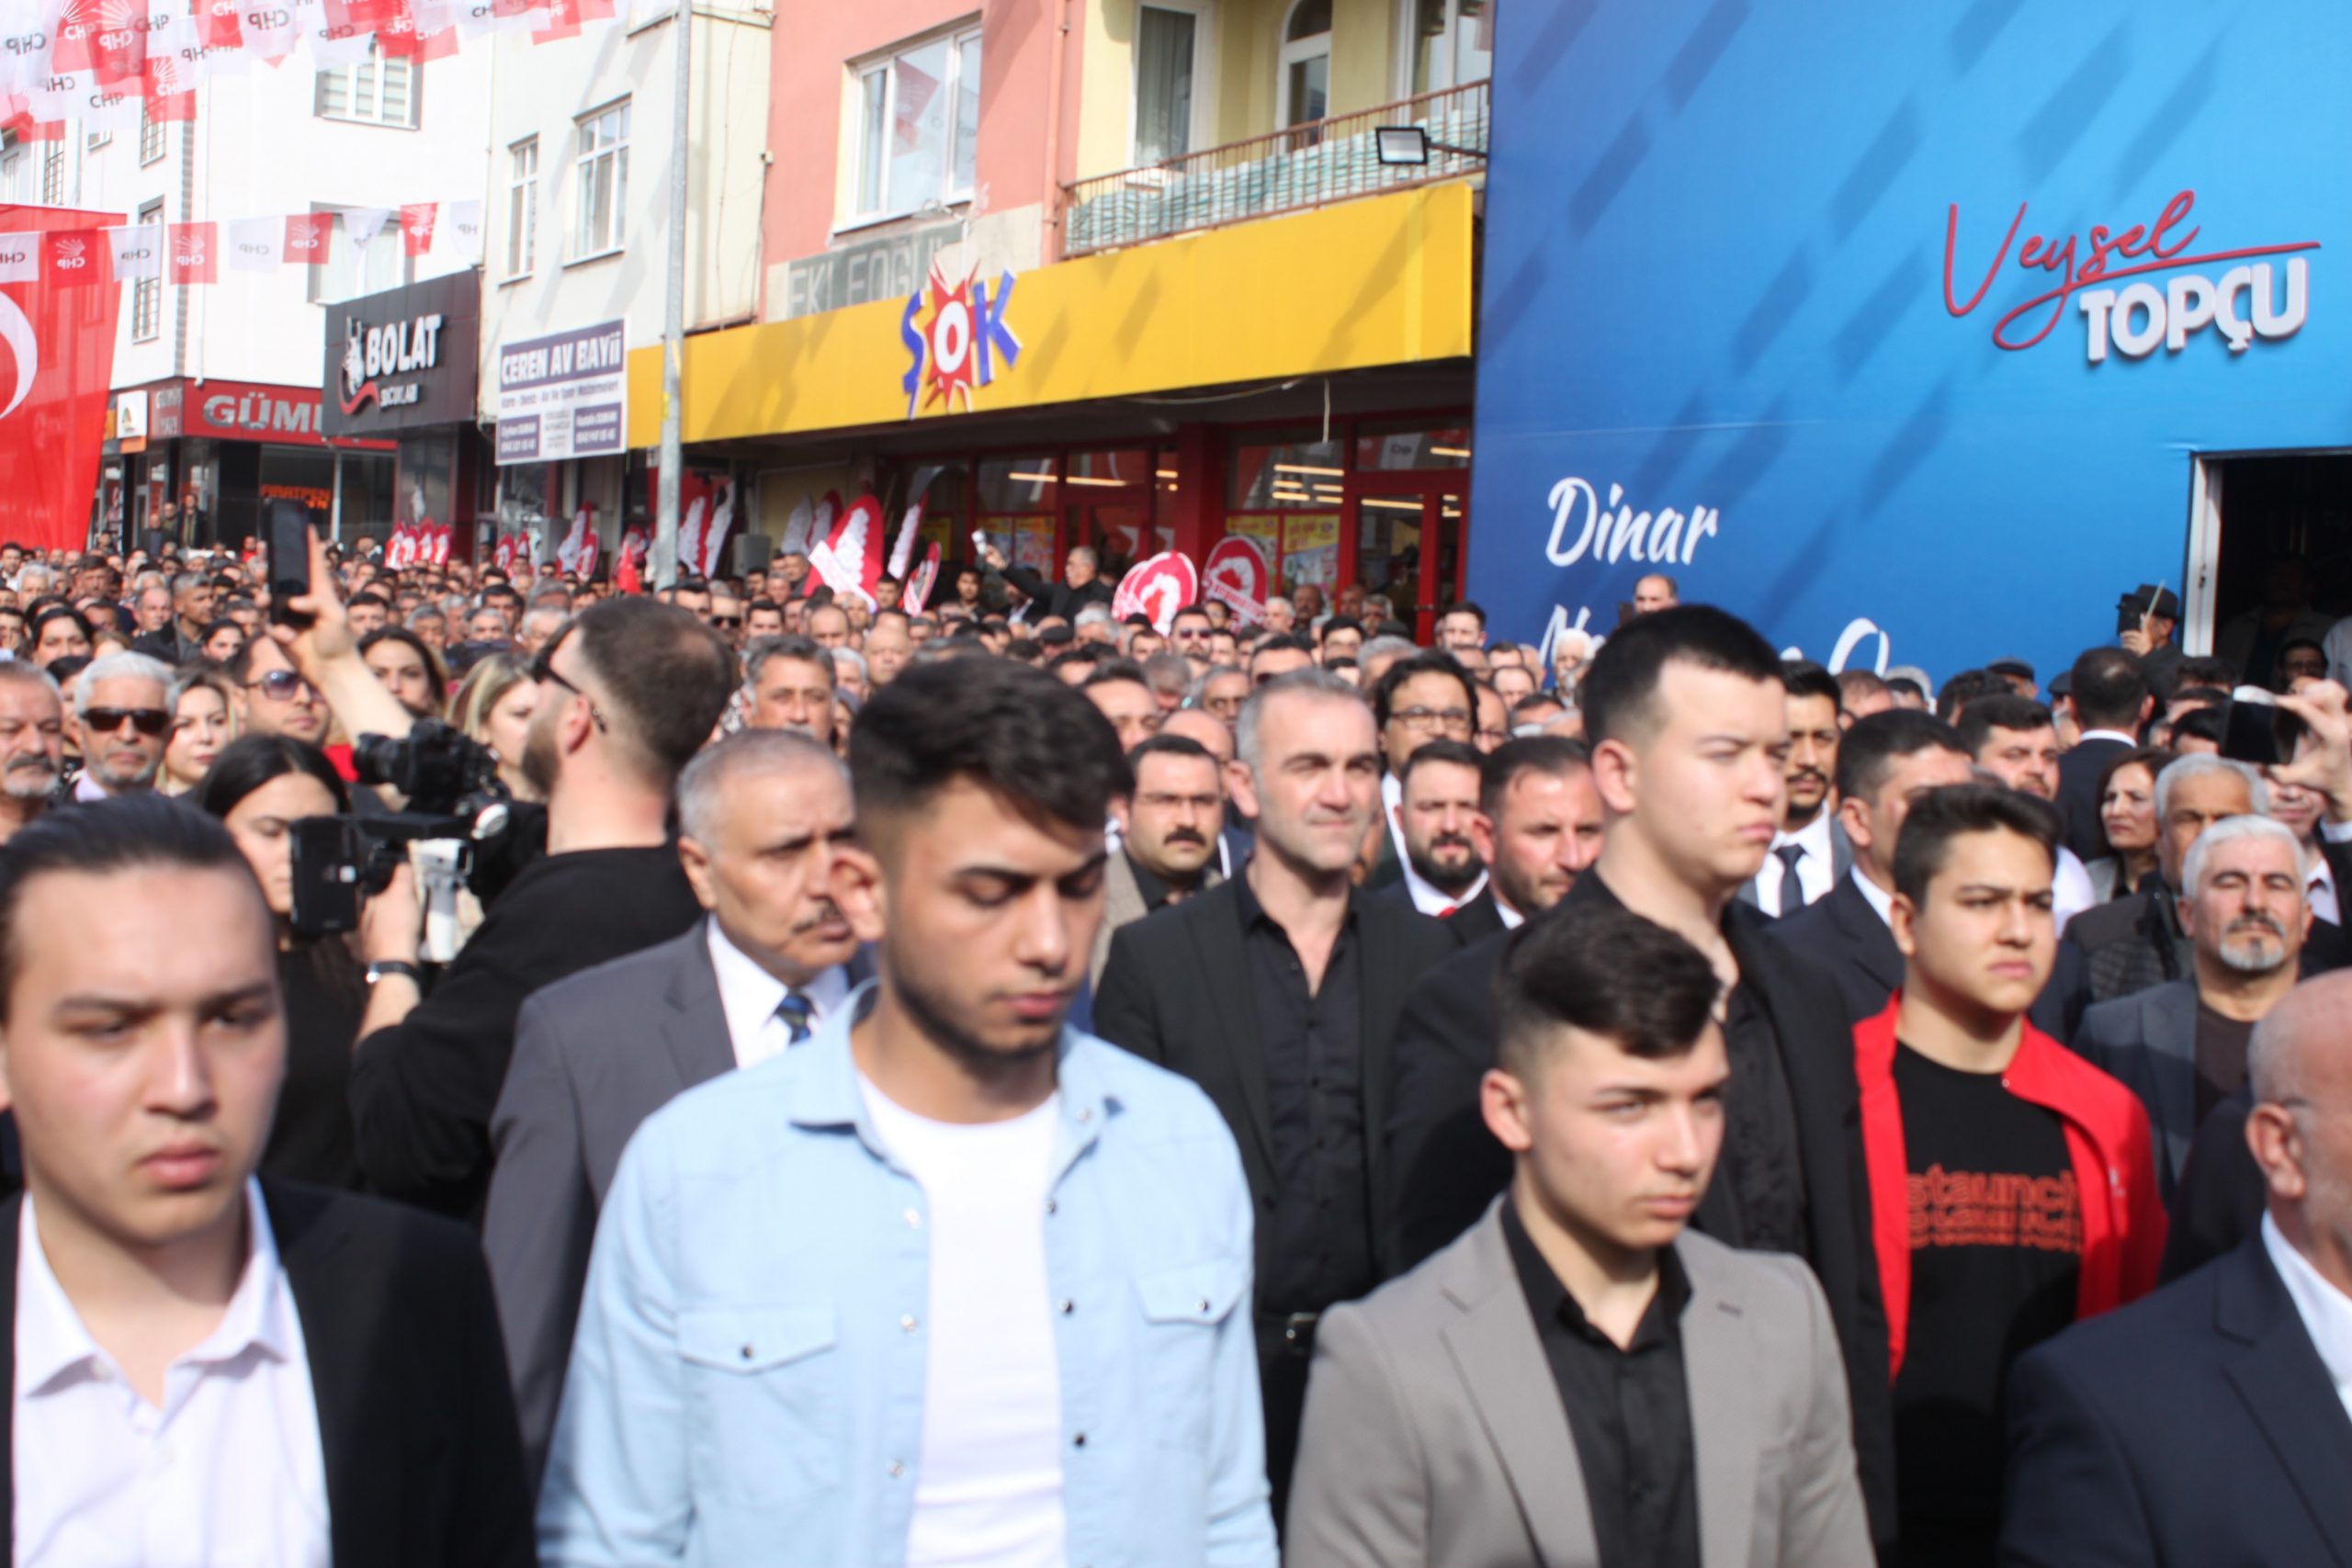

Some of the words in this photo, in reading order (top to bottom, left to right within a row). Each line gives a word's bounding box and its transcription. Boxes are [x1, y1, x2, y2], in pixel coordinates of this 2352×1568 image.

[1943, 189, 2321, 350] Veysel
[367, 313, 442, 378] BOLAT
[2079, 257, 2308, 362] TOPÇU
[502, 347, 548, 385] CEREN
[550, 343, 574, 377] AV
[202, 391, 323, 434] GÜM
[1545, 477, 1719, 567] Dinar
